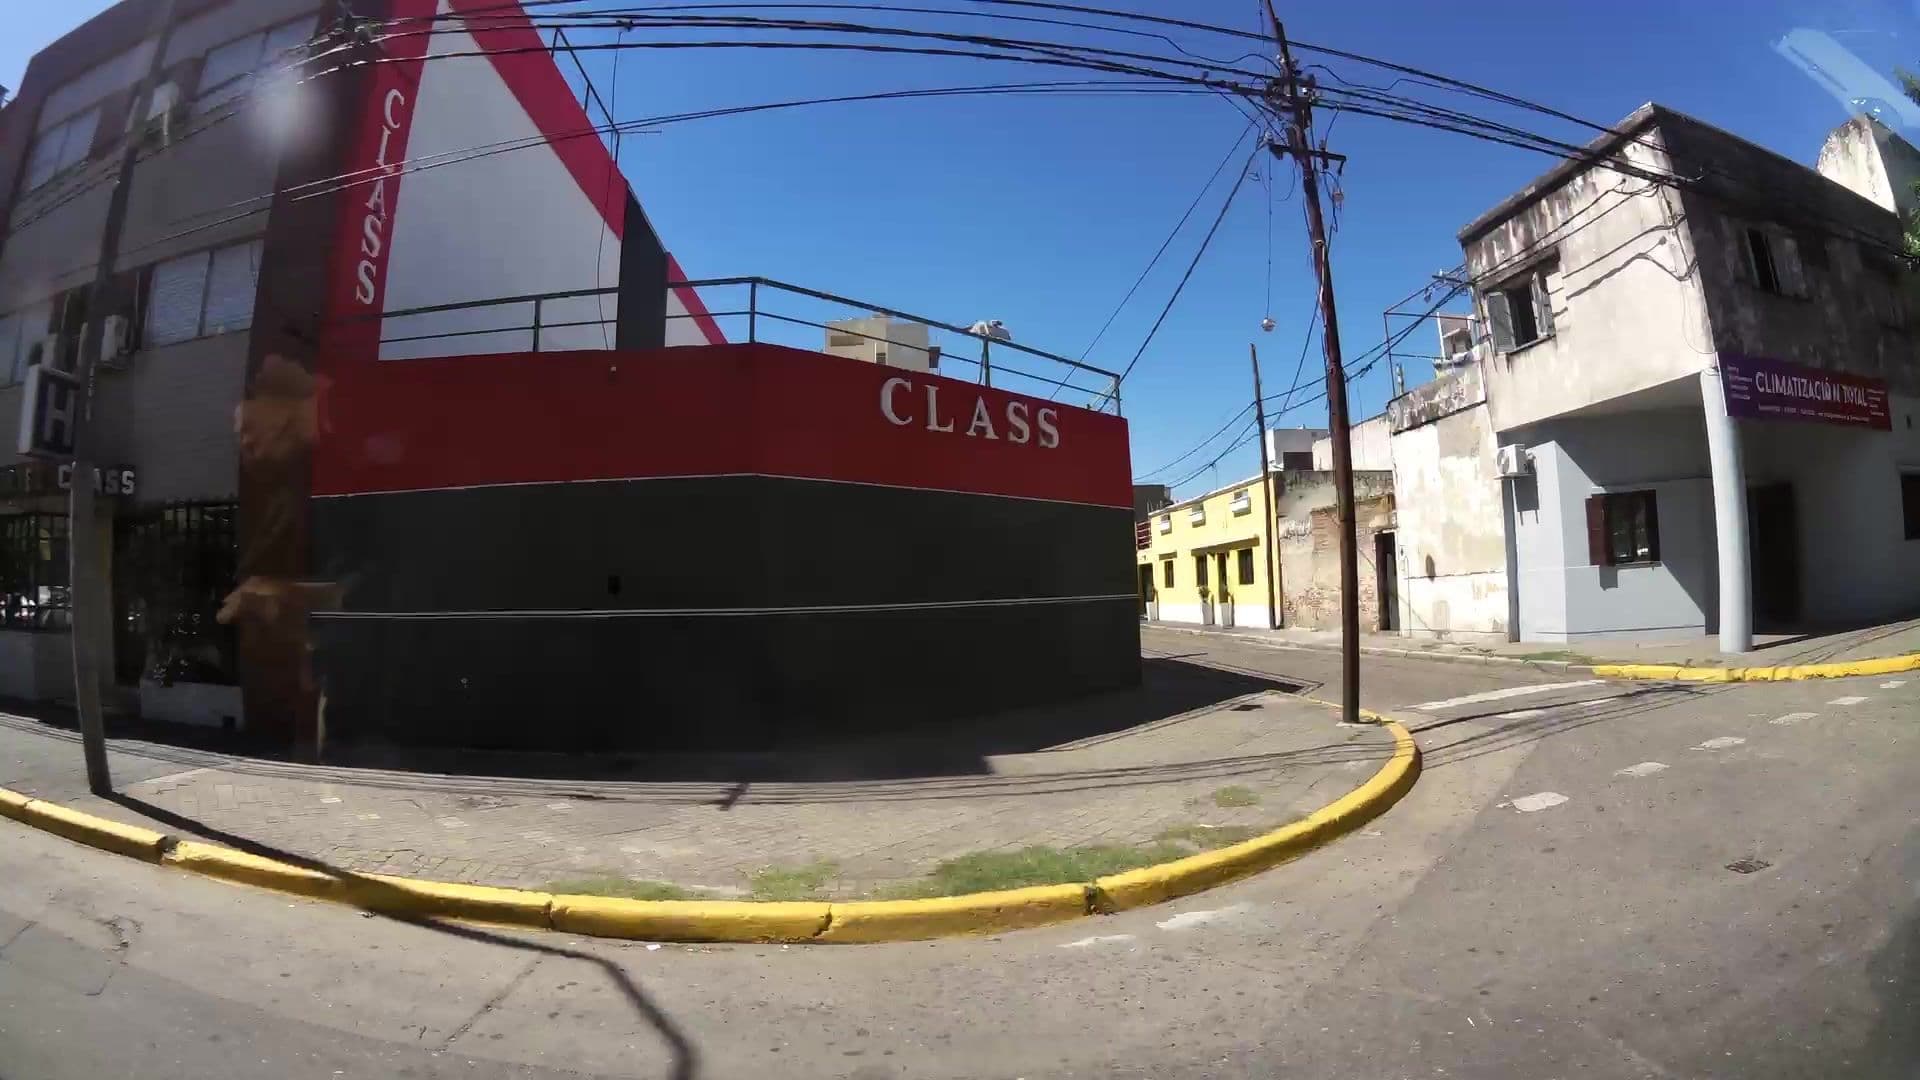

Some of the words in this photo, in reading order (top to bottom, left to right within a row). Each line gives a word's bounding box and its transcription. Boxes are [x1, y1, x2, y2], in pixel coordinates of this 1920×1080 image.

[356, 88, 404, 305] CLASS
[44, 382, 75, 447] H
[880, 377, 1060, 449] CLASS
[1755, 371, 1840, 402] CLIMATIZACIÓN
[1841, 384, 1868, 407] TOTAL
[57, 466, 136, 495] CASS
